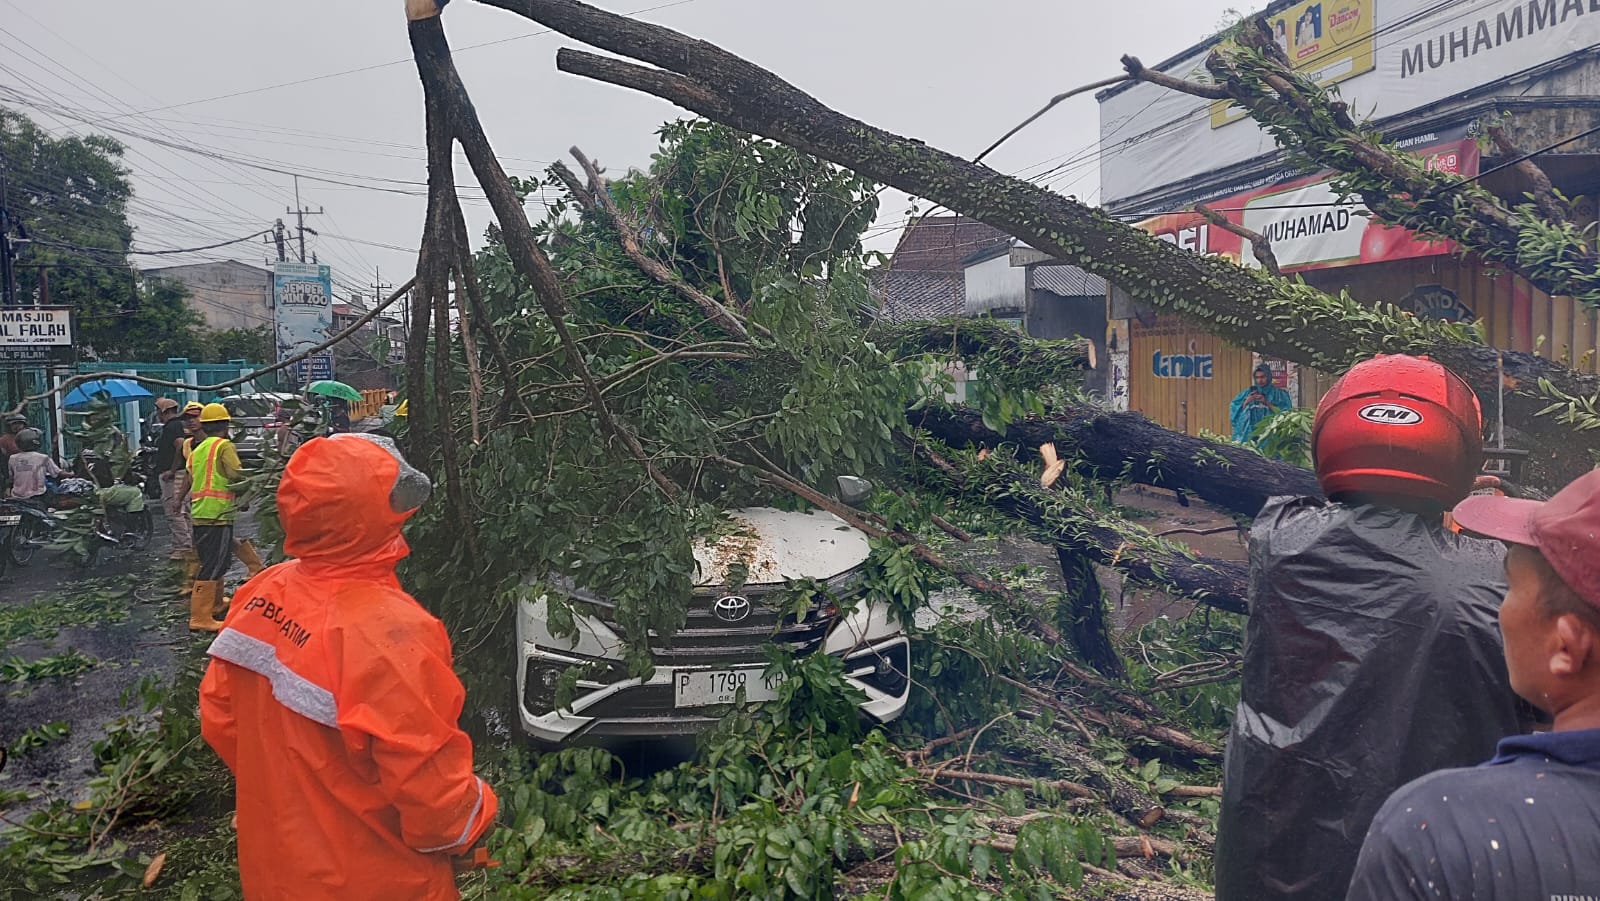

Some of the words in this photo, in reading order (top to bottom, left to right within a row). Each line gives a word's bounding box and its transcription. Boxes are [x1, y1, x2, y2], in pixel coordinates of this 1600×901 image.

[1262, 208, 1349, 243] MUHAMAD
[283, 283, 324, 295] JEMBER
[281, 293, 305, 304] MINI
[307, 294, 328, 306] ZOO
[2, 312, 54, 322] MASJID
[19, 323, 66, 336] FALAH
[13, 351, 46, 359] FALAH
[1366, 408, 1411, 419] CNI
[680, 675, 690, 695] P
